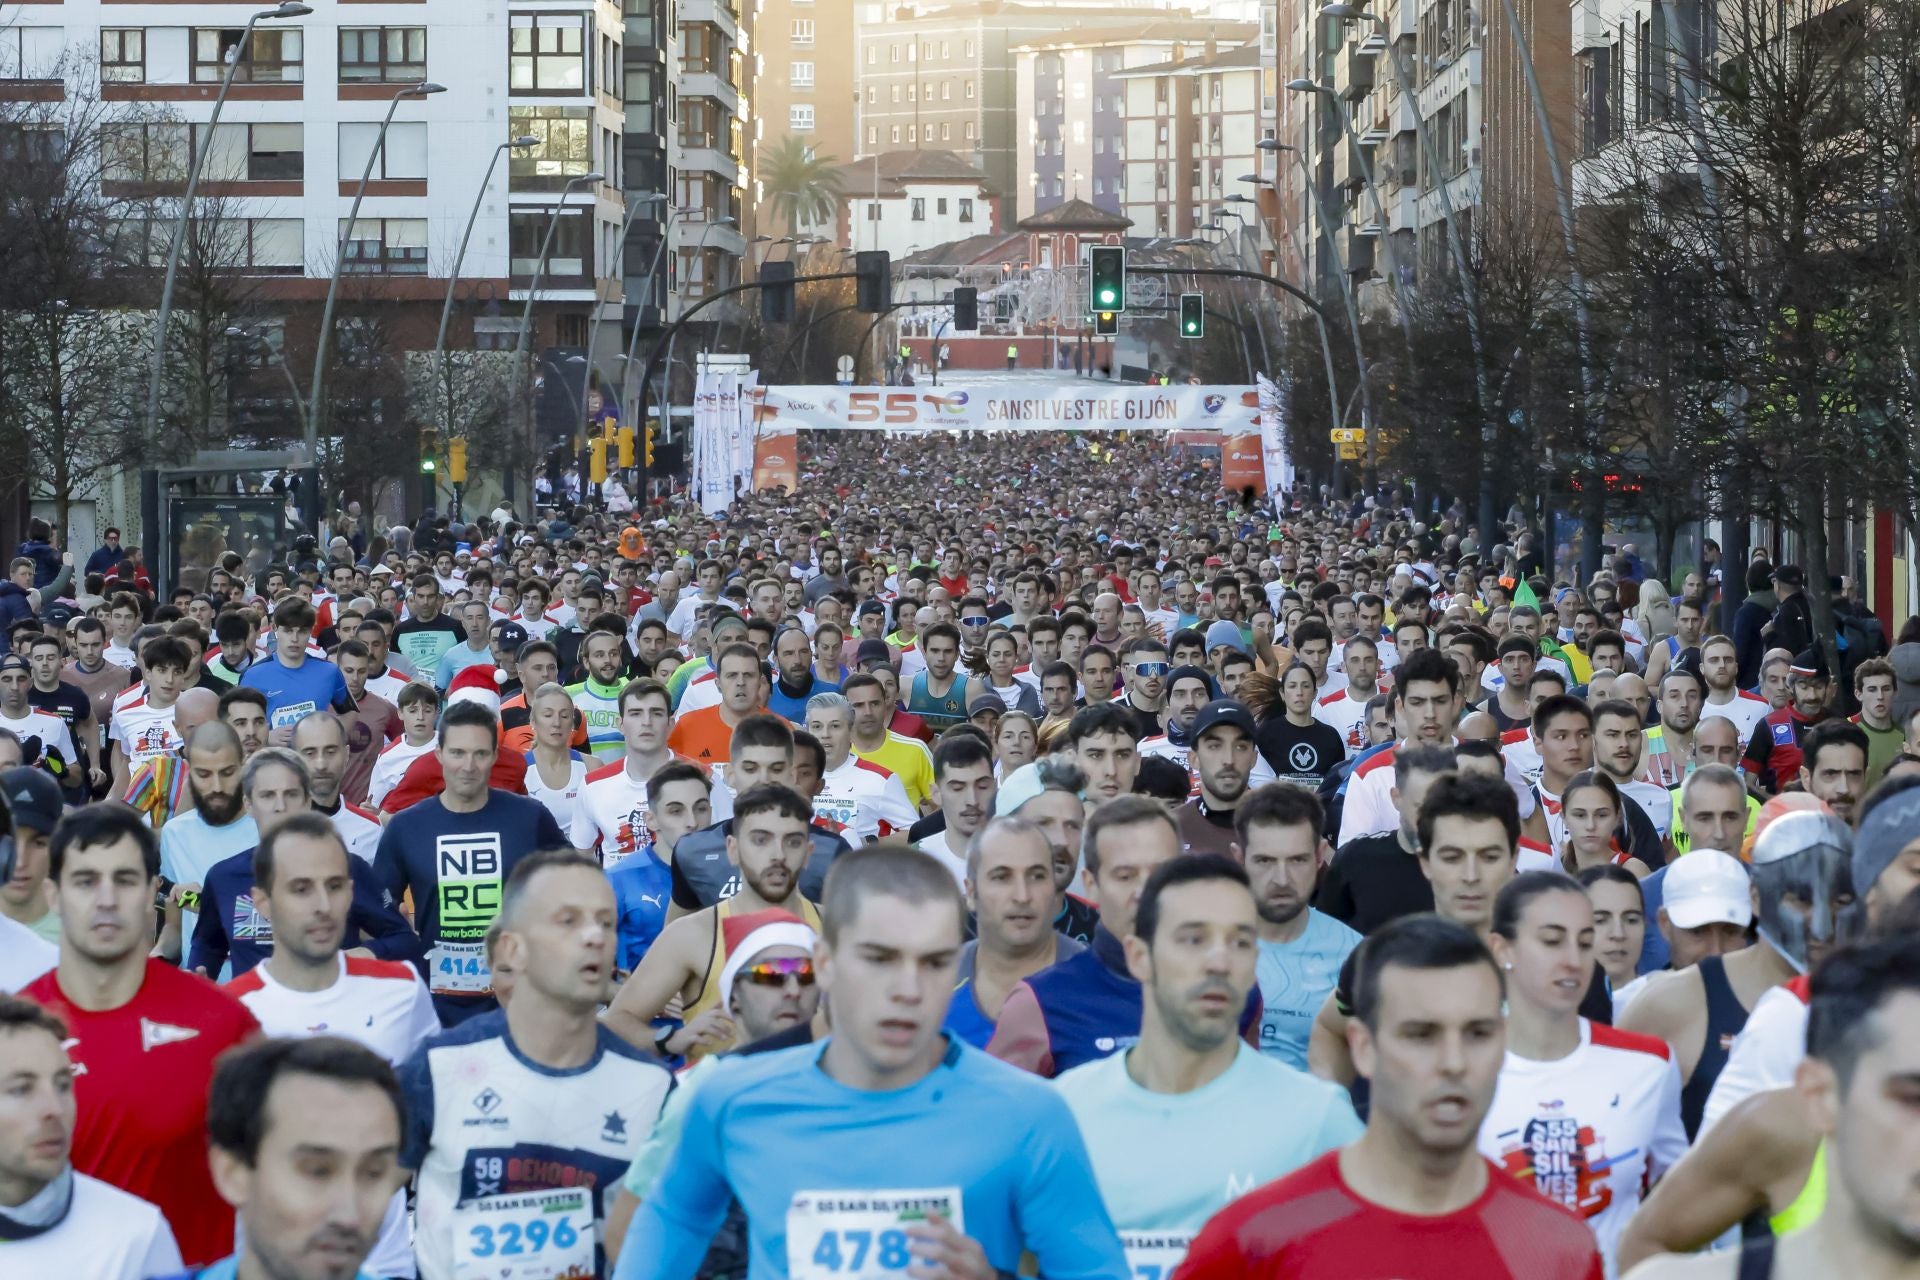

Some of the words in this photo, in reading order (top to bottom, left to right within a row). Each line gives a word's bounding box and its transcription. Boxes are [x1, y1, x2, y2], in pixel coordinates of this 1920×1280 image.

[848, 392, 918, 424] 55
[1124, 394, 1177, 421] GIJÓN
[632, 825, 649, 836] SIL
[441, 848, 498, 877] NB
[443, 883, 498, 911] RC
[1548, 1118, 1578, 1137] 55
[1530, 1132, 1577, 1153] SAN
[474, 1156, 503, 1180] 58
[1533, 1152, 1577, 1175] SIL
[1534, 1173, 1578, 1197] VES
[495, 1198, 519, 1212] SAN
[522, 1191, 584, 1210] SILVESTRE
[838, 1200, 868, 1213] SAN
[871, 1196, 950, 1213] SILVESTRE
[469, 1215, 578, 1258] 3296
[1137, 1237, 1164, 1249] SAN
